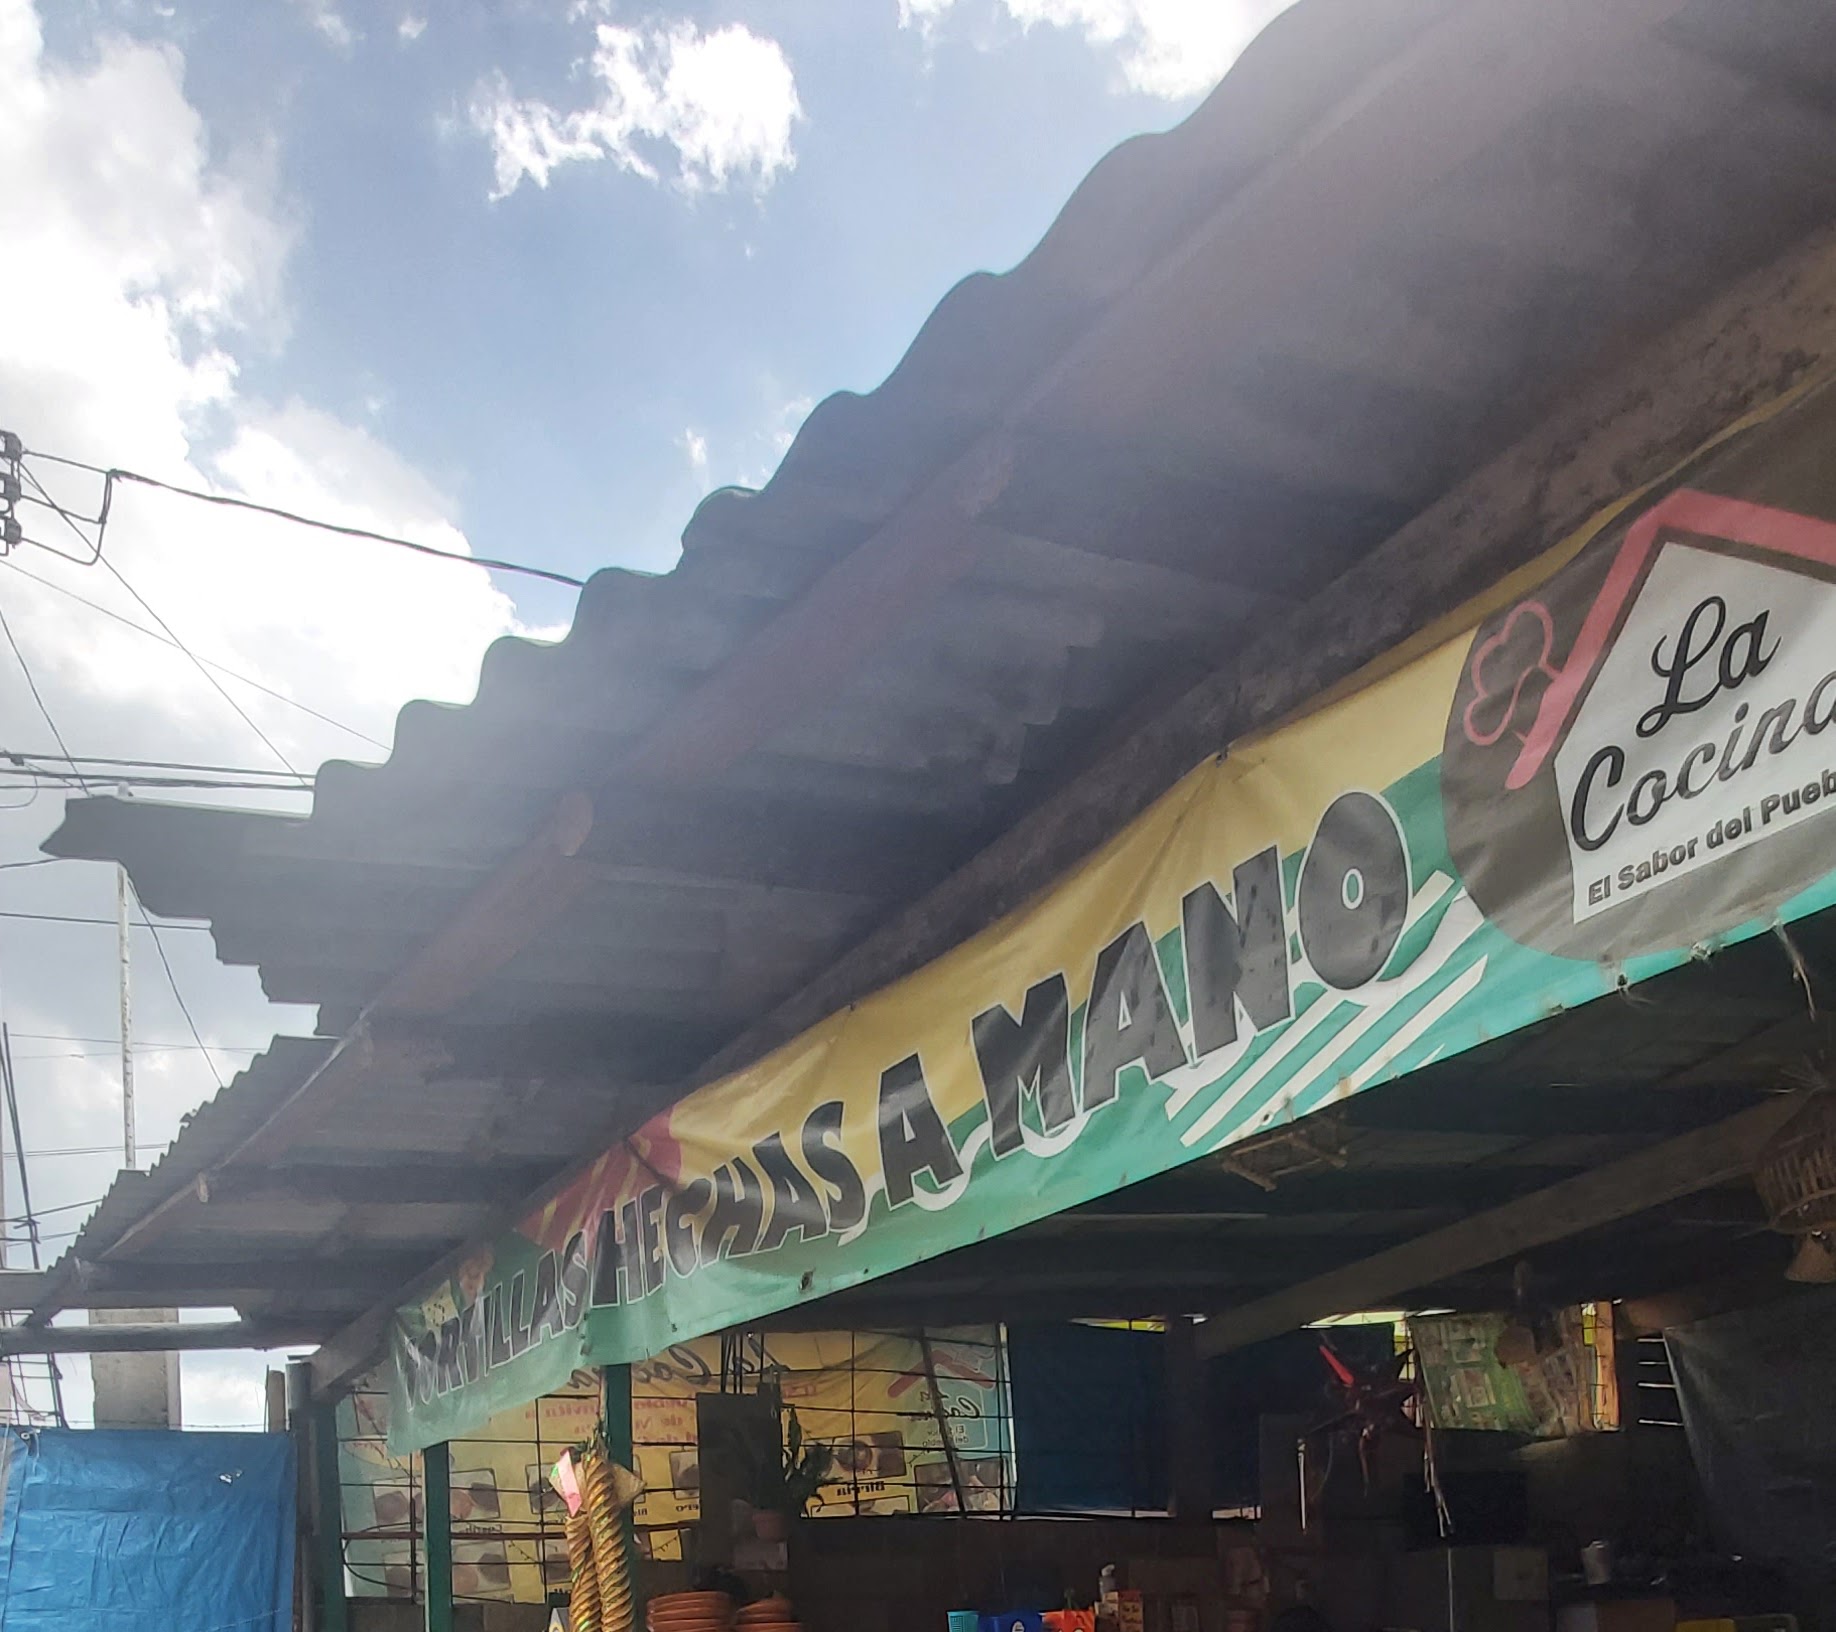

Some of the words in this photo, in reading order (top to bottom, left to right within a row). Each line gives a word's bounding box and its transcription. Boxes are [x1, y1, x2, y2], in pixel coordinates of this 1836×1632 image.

[1635, 596, 1782, 738] La
[1588, 875, 1611, 906] El
[1617, 838, 1698, 890] Sabor
[1706, 806, 1752, 849] del
[590, 1101, 867, 1309] HECHAS
[877, 1052, 964, 1211] A
[970, 791, 1412, 1160] MANO
